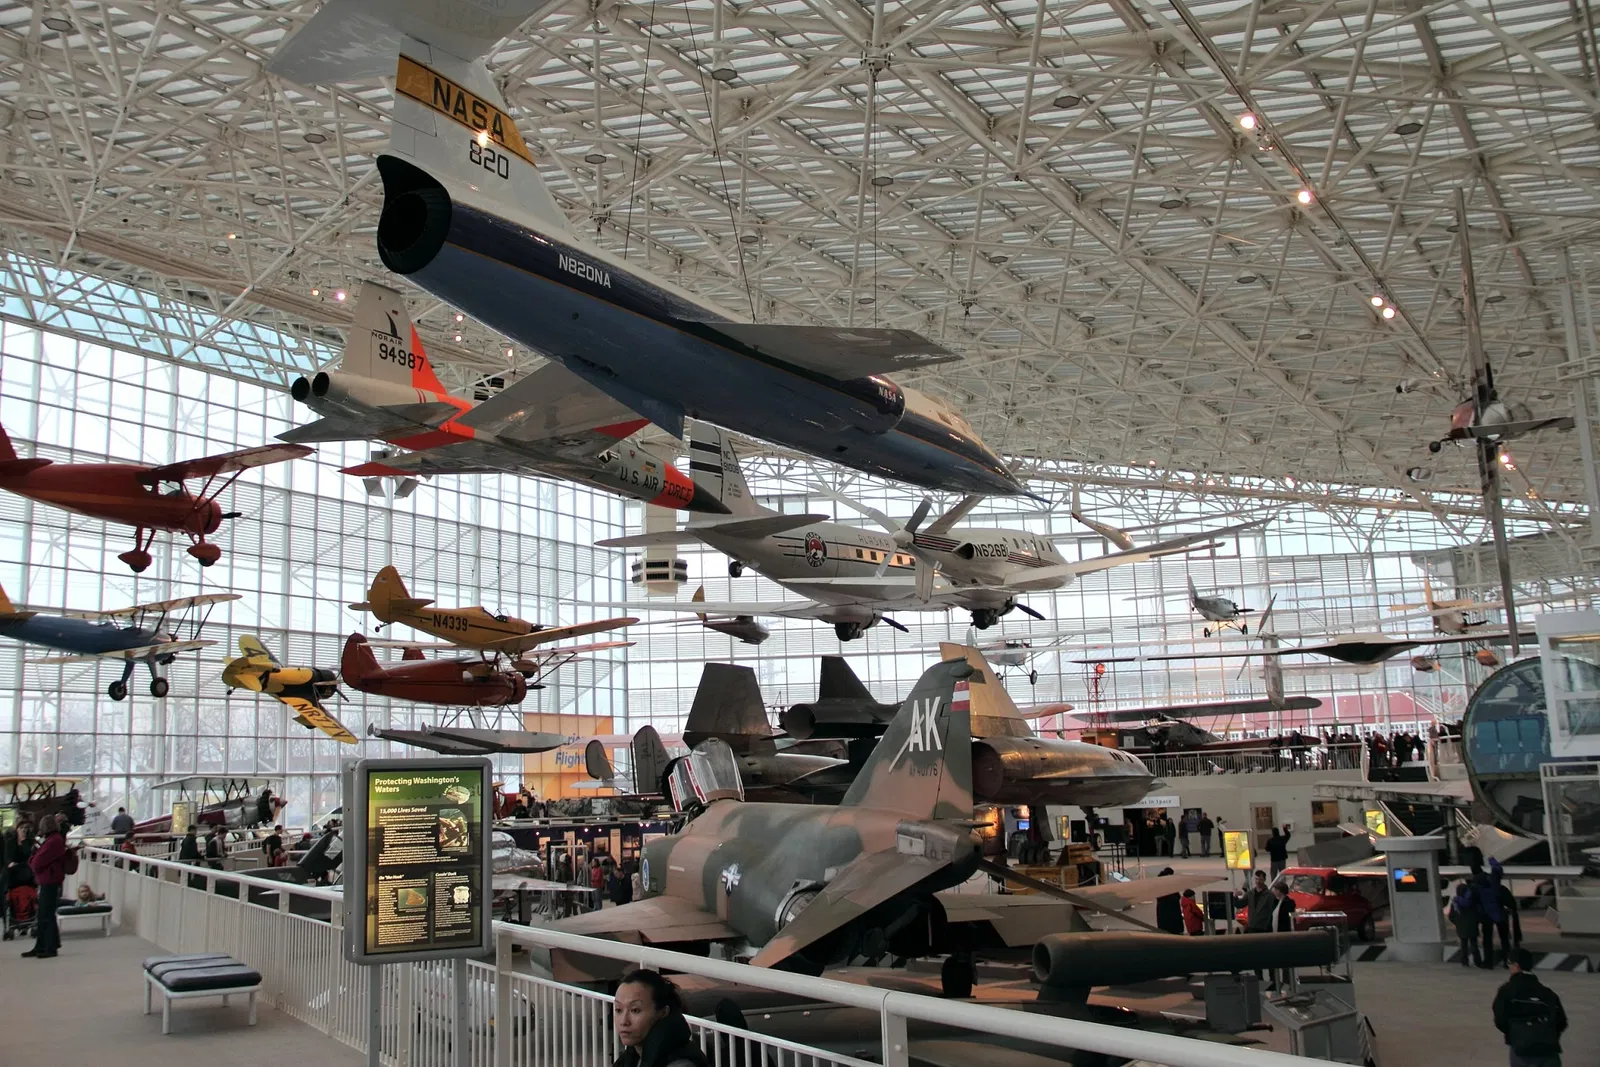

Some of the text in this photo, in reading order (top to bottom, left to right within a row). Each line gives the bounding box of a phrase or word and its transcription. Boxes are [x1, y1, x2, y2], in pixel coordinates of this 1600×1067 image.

[433, 77, 505, 143] NASA
[469, 139, 509, 180] 820
[558, 253, 612, 289] N820NA
[378, 342, 425, 372] 94987
[878, 385, 897, 403] NASA
[722, 450, 731, 460] NC
[643, 474, 659, 492] AIR
[660, 480, 692, 502] FORCE
[857, 533, 891, 549] ALASKA
[433, 613, 468, 632] N4339
[293, 703, 351, 738] NR77V
[903, 696, 942, 754] AK
[555, 751, 587, 769] Flight
[374, 776, 460, 786] Protecting Washington's
